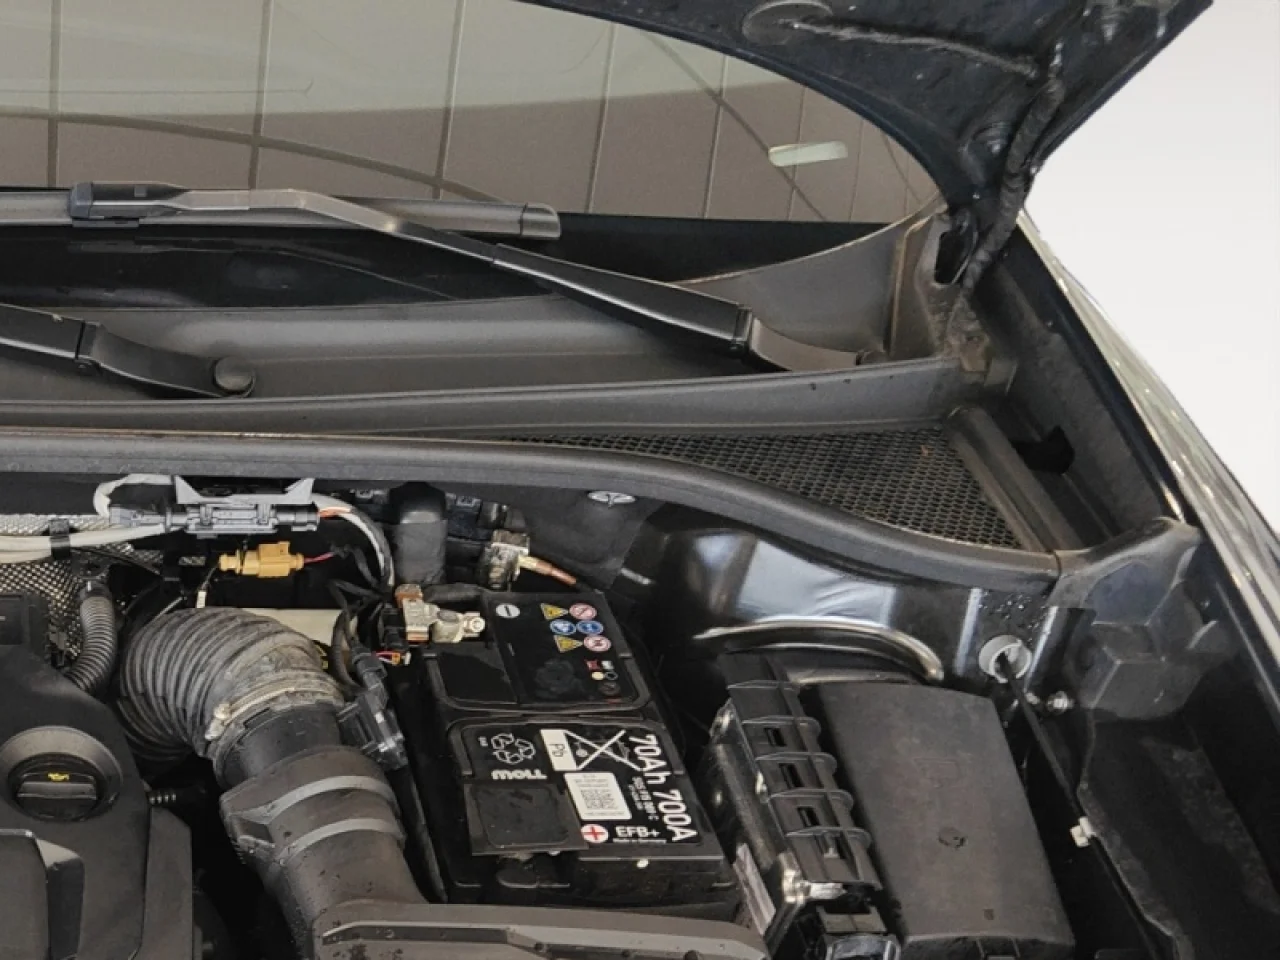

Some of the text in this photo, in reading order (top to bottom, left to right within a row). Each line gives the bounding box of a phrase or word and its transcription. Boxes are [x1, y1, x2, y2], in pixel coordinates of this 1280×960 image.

[629, 734, 671, 785] 70Ah
[653, 789, 698, 842] 700A
[615, 825, 660, 838] EFB+
